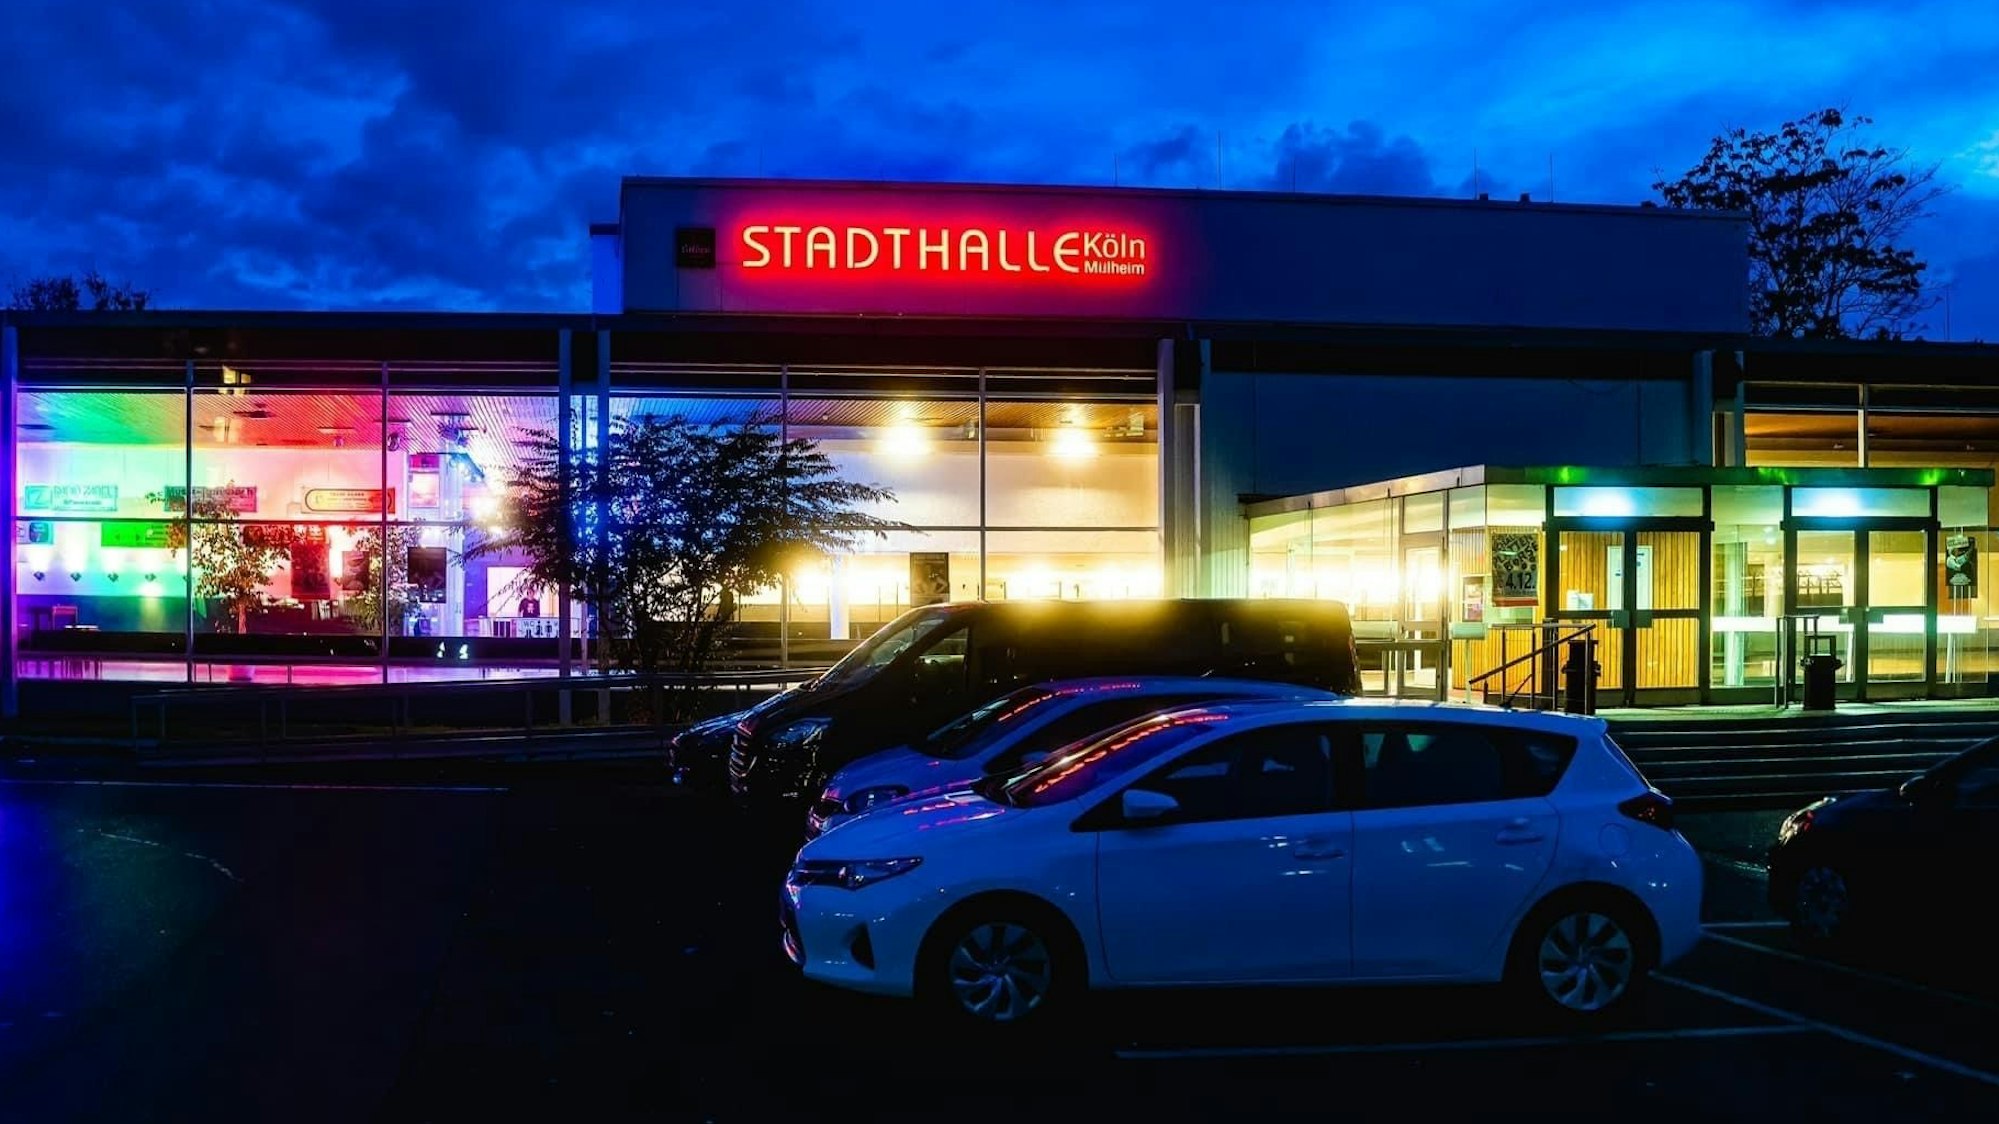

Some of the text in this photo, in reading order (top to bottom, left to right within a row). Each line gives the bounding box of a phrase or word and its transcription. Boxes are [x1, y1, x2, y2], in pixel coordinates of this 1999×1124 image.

[742, 225, 1080, 274] STADTHALLE
[1084, 231, 1146, 259] Köln
[1505, 572, 1536, 590] 4.12.
